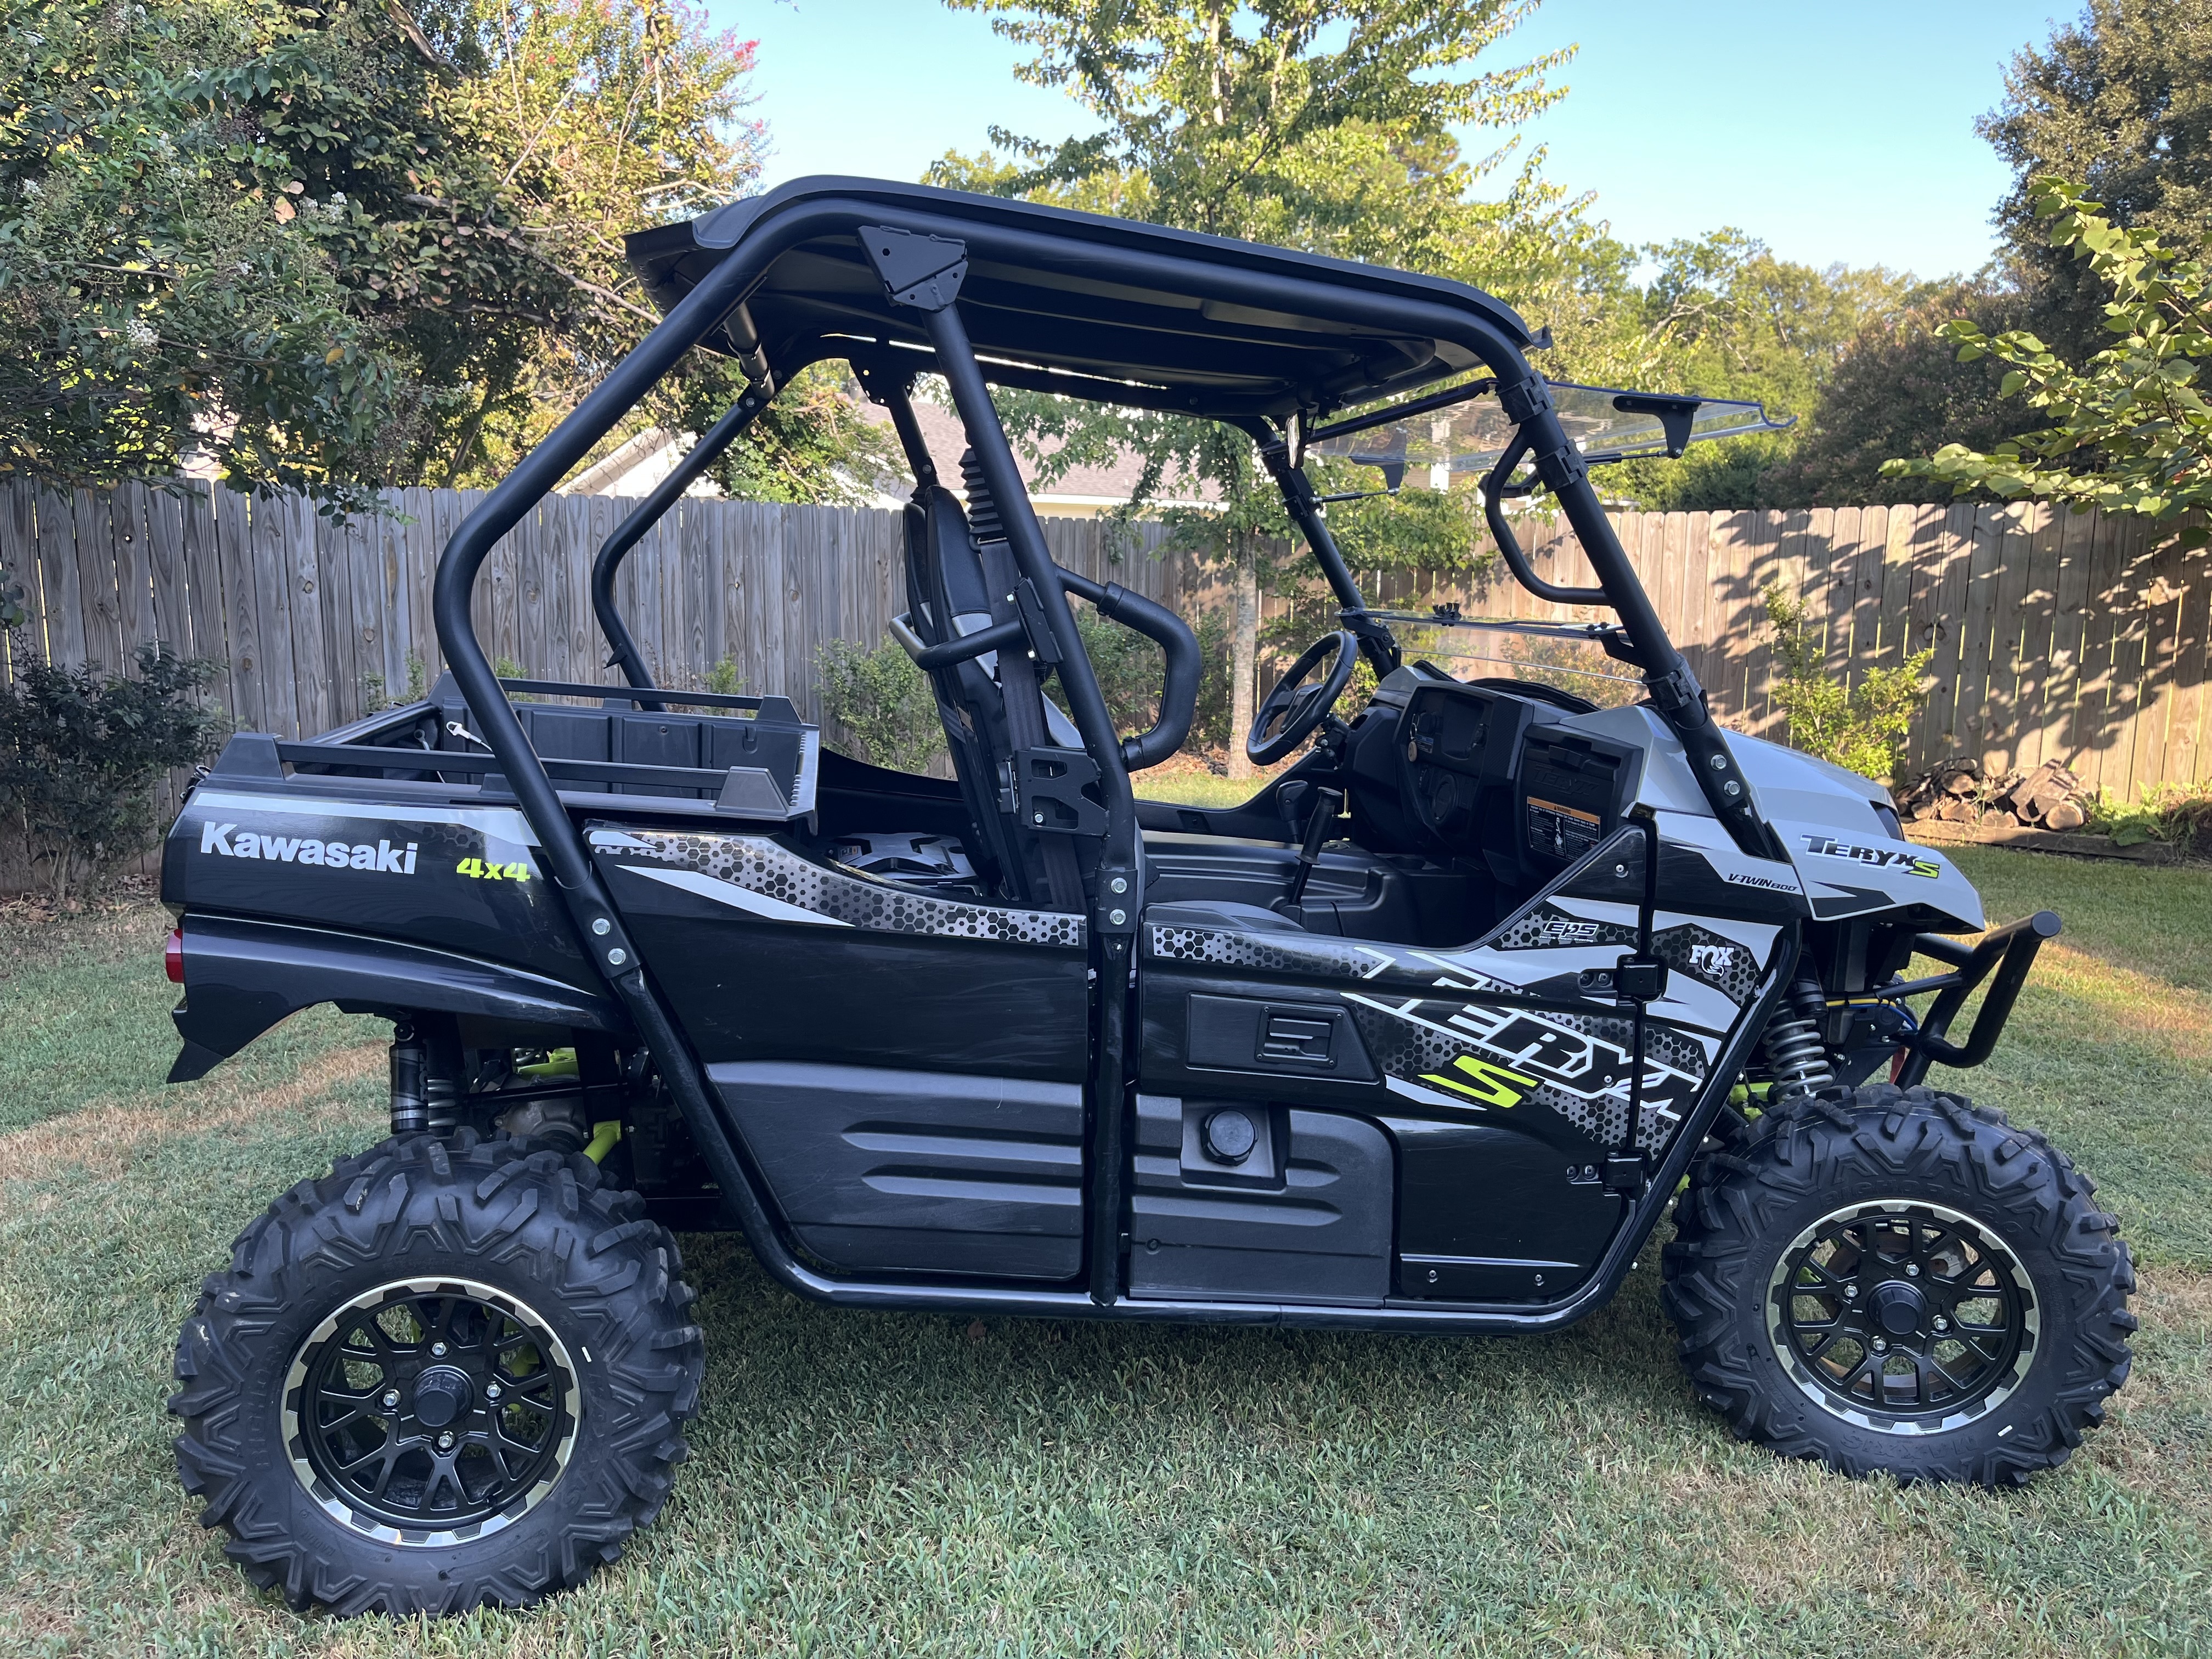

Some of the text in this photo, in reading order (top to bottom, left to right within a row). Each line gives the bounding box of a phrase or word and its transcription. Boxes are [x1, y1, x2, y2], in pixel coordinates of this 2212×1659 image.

[201, 821, 417, 874] Kawasaki
[1800, 833, 1917, 870] TERYX
[456, 858, 530, 882] 4x4
[1689, 945, 1734, 977] FOX
[1819, 1180, 1971, 1206] BIGHORN
[245, 1323, 297, 1470] BIGHORN
